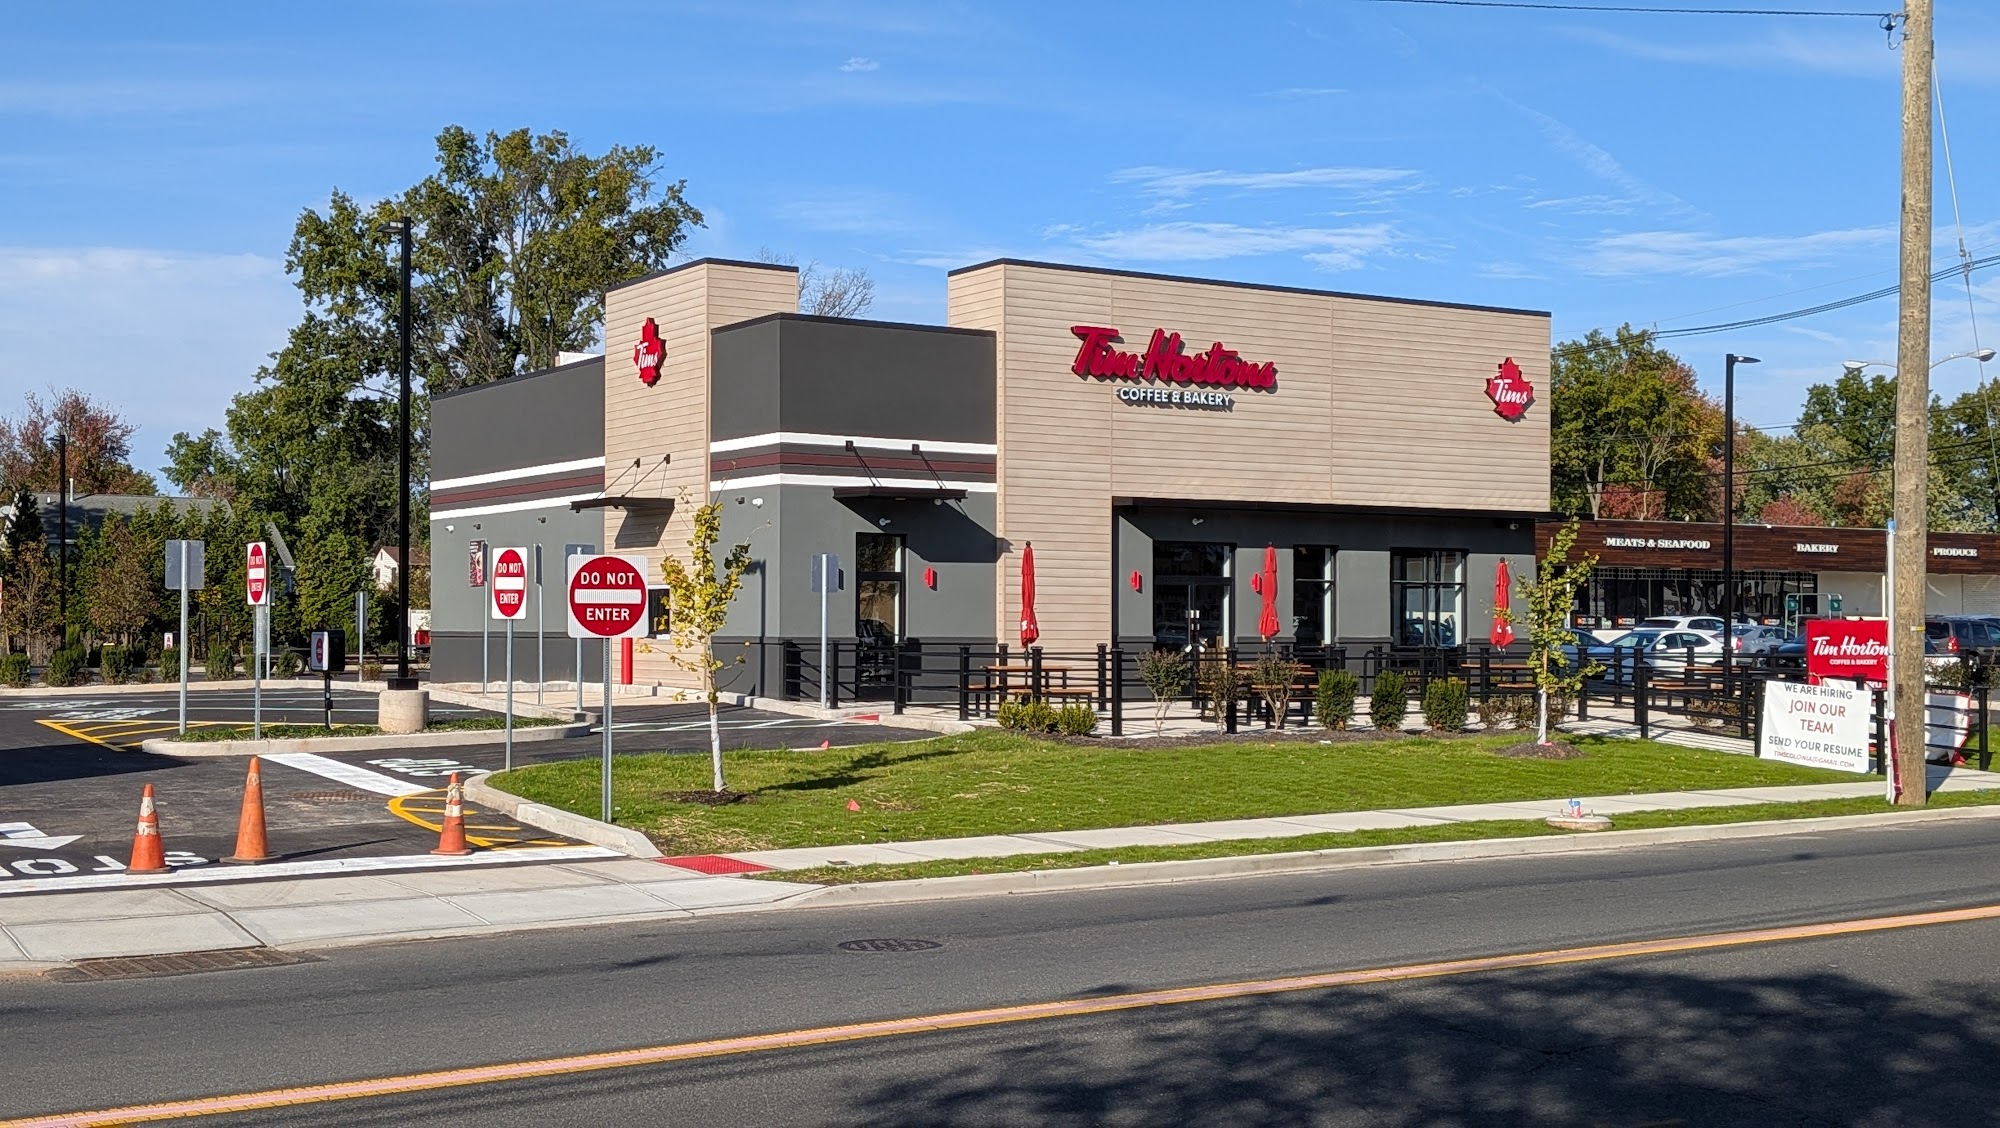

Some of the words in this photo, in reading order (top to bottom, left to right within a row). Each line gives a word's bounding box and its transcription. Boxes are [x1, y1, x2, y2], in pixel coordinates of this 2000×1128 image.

[637, 341, 658, 369] Tims
[1070, 325, 1139, 379] Tim
[1142, 328, 1275, 388] Hortons
[1120, 387, 1169, 402] COFFEE
[1171, 391, 1181, 403] &
[1183, 391, 1232, 406] BAKERY
[1493, 378, 1528, 404] Tims
[1606, 537, 1646, 548] MEATS
[1646, 539, 1657, 548] &
[1657, 539, 1711, 549] SEAFOOD
[1796, 543, 1839, 553] BAKERY
[250, 556, 255, 565] DO
[1933, 547, 1978, 557] PRODUCE
[498, 562, 507, 574] DO
[508, 562, 522, 574] NOT
[580, 572, 600, 585] DO
[606, 572, 635, 585] NOT
[500, 593, 519, 604] ENTER
[586, 608, 630, 621] ENTER
[1812, 636, 1838, 656] Tim
[1840, 635, 1889, 656] Horton
[1784, 683, 1798, 693] WE
[1800, 686, 1818, 696] ARE
[1820, 687, 1853, 700] HIRING
[1788, 699, 1816, 714] JOIN
[1820, 703, 1846, 718] OUR
[1800, 718, 1834, 735] TEAM
[1768, 735, 1792, 747] SEND
[1794, 738, 1821, 752] YOUR
[1823, 743, 1863, 758] RESUME
